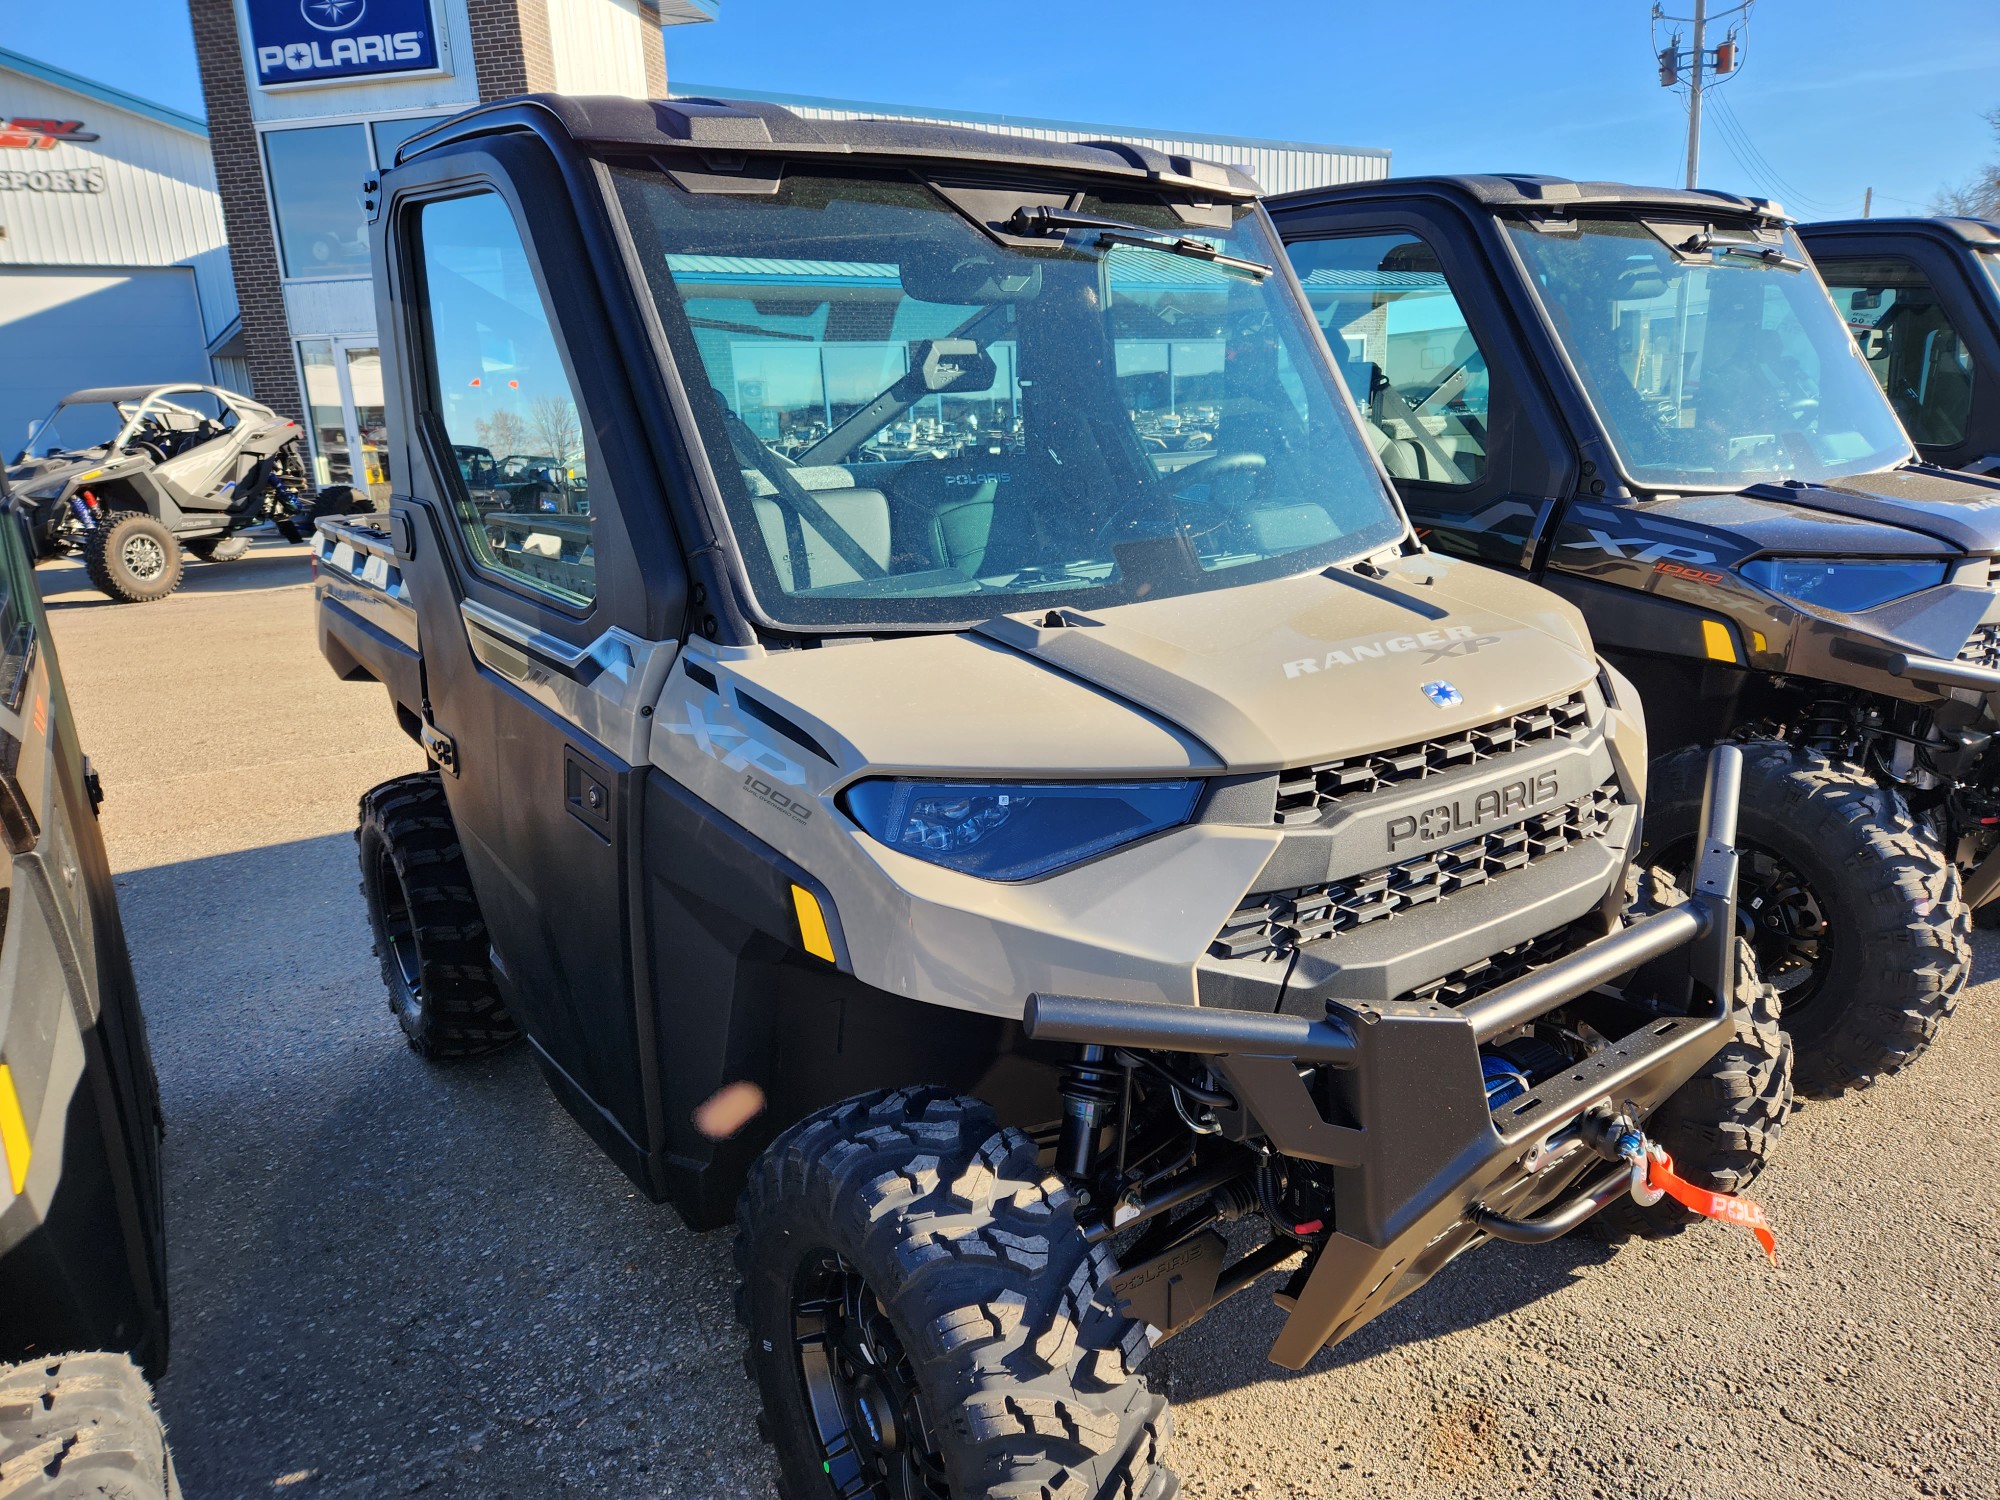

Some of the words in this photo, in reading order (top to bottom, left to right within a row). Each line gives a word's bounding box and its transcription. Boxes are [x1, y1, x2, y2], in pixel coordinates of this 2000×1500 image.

[258, 32, 422, 73] POLARIS
[945, 473, 1011, 486] POLARIS
[1561, 528, 1718, 565] XP
[1653, 562, 1723, 583] 1000
[1282, 625, 1479, 680] RANGER
[1418, 636, 1502, 666] XP
[658, 700, 807, 786] XP
[744, 774, 813, 820] 1000
[1386, 769, 1559, 854] POLARIS
[1115, 1244, 1203, 1296] POLARIS
